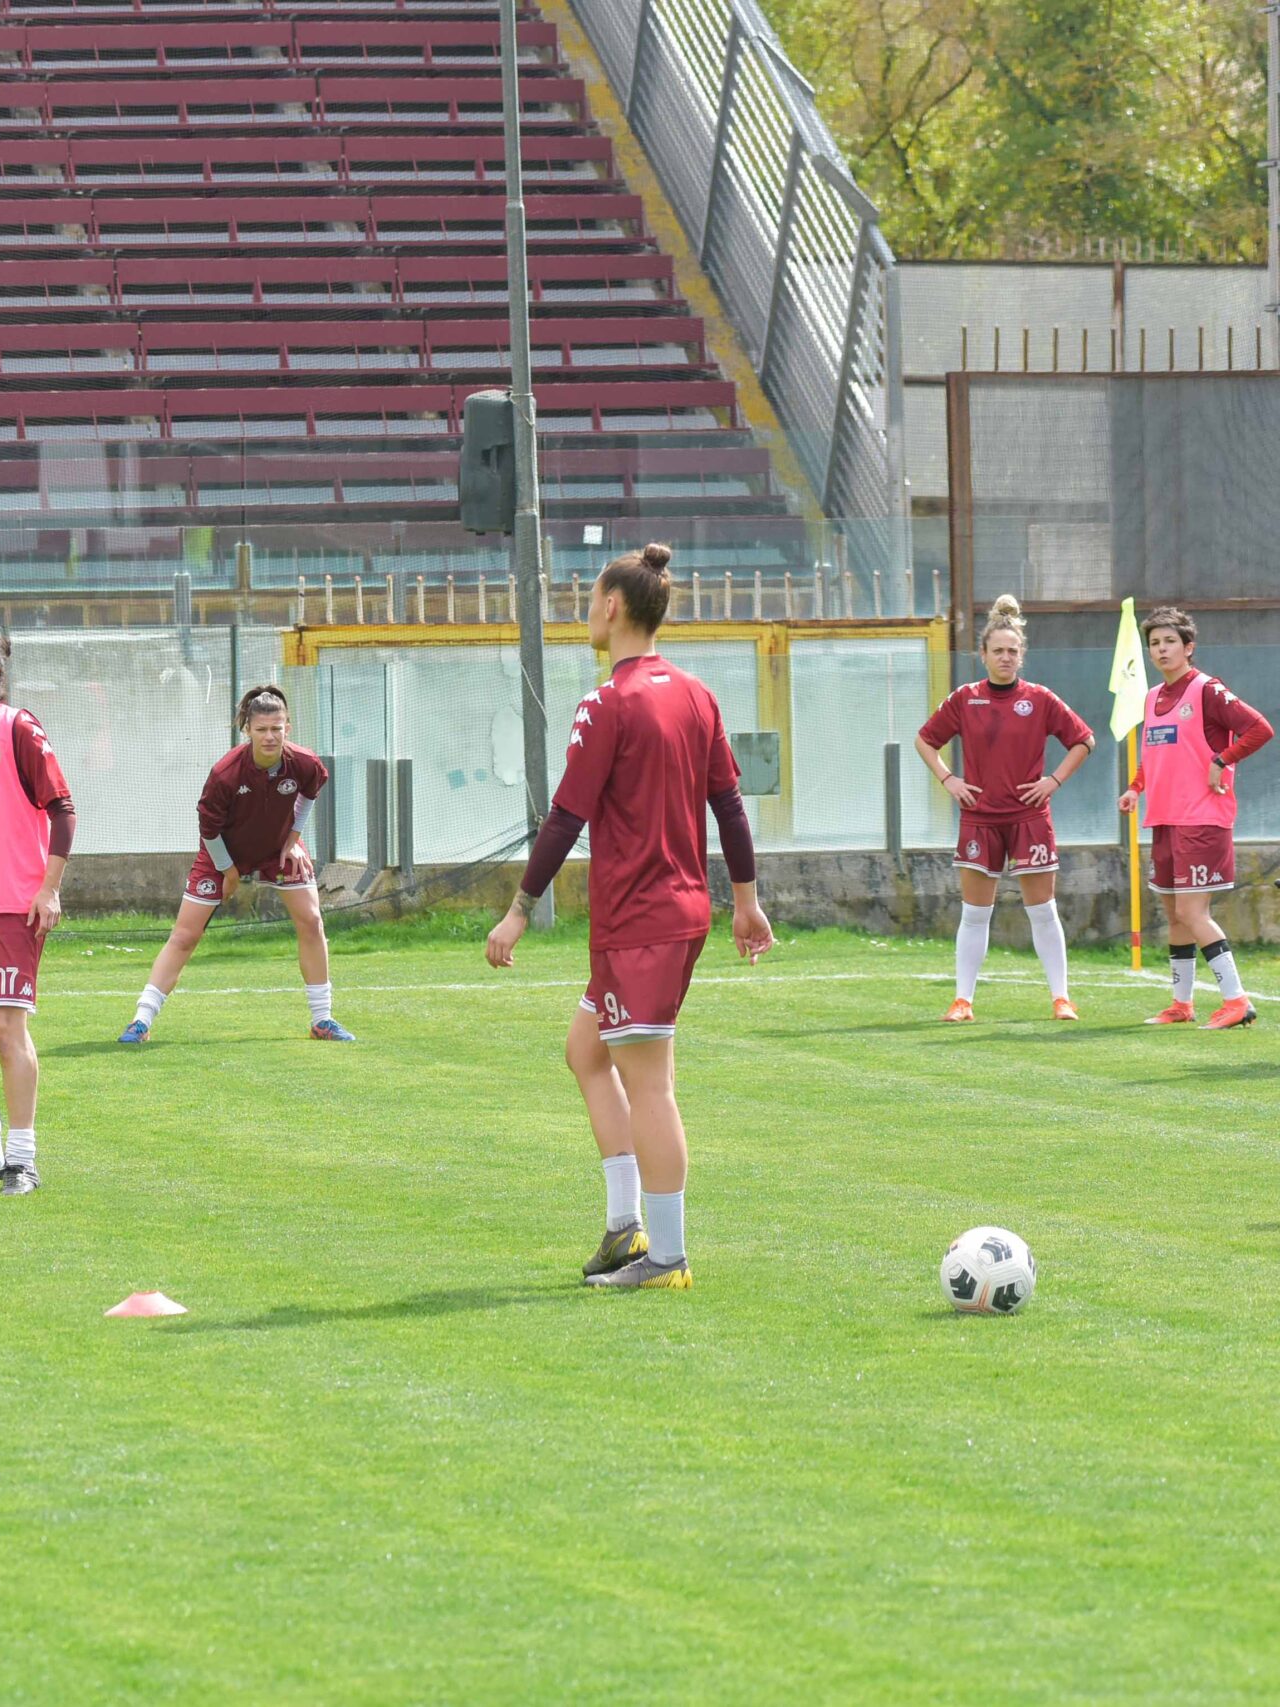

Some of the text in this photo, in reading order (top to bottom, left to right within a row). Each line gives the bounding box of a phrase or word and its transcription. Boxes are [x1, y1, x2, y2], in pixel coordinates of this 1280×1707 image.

[1029, 844, 1048, 866] 28
[1189, 864, 1208, 886] 13
[604, 991, 620, 1026] 9
